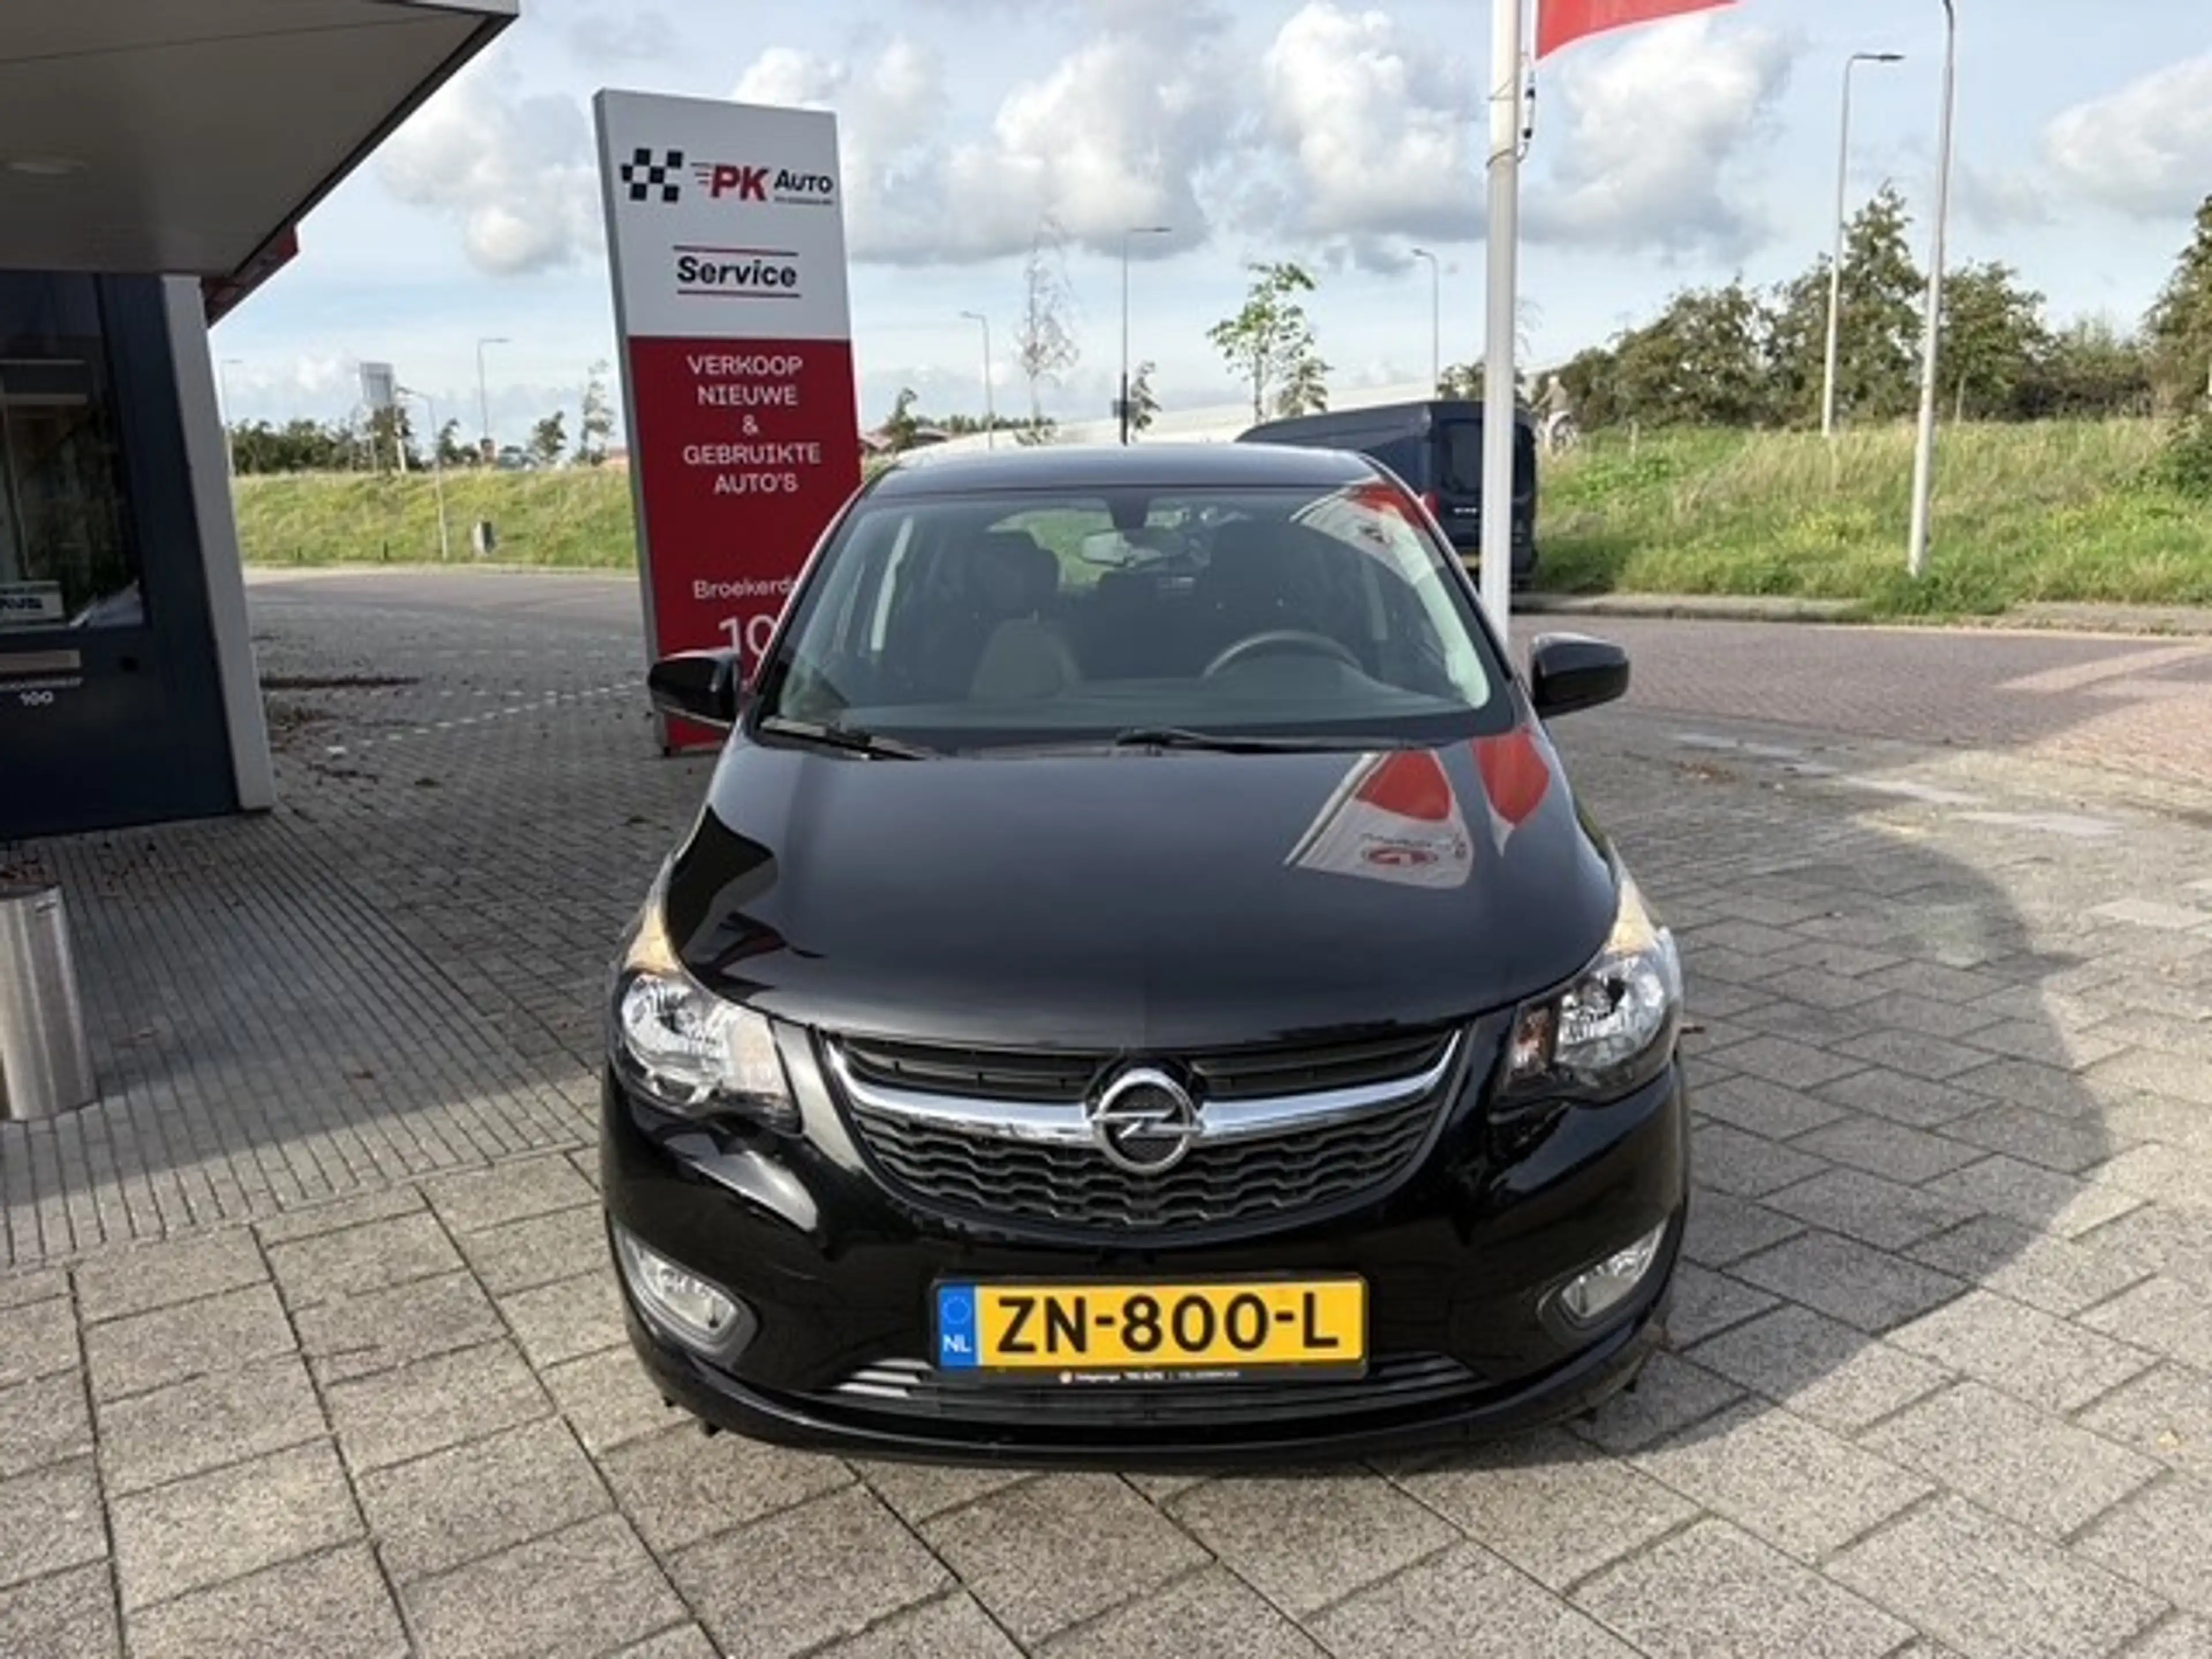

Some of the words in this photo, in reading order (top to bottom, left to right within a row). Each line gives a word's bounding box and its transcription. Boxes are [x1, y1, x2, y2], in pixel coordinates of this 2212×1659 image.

[710, 164, 771, 201] PK
[677, 255, 797, 287] Service
[686, 354, 803, 376] VERKOOP
[697, 384, 799, 406] NIEUWE
[742, 414, 759, 435] &
[683, 442, 821, 465] GEBRUIKTE
[713, 473, 800, 495] AUTO'S
[996, 1291, 1339, 1354] ZN-800-L
[943, 1334, 972, 1353] NL
